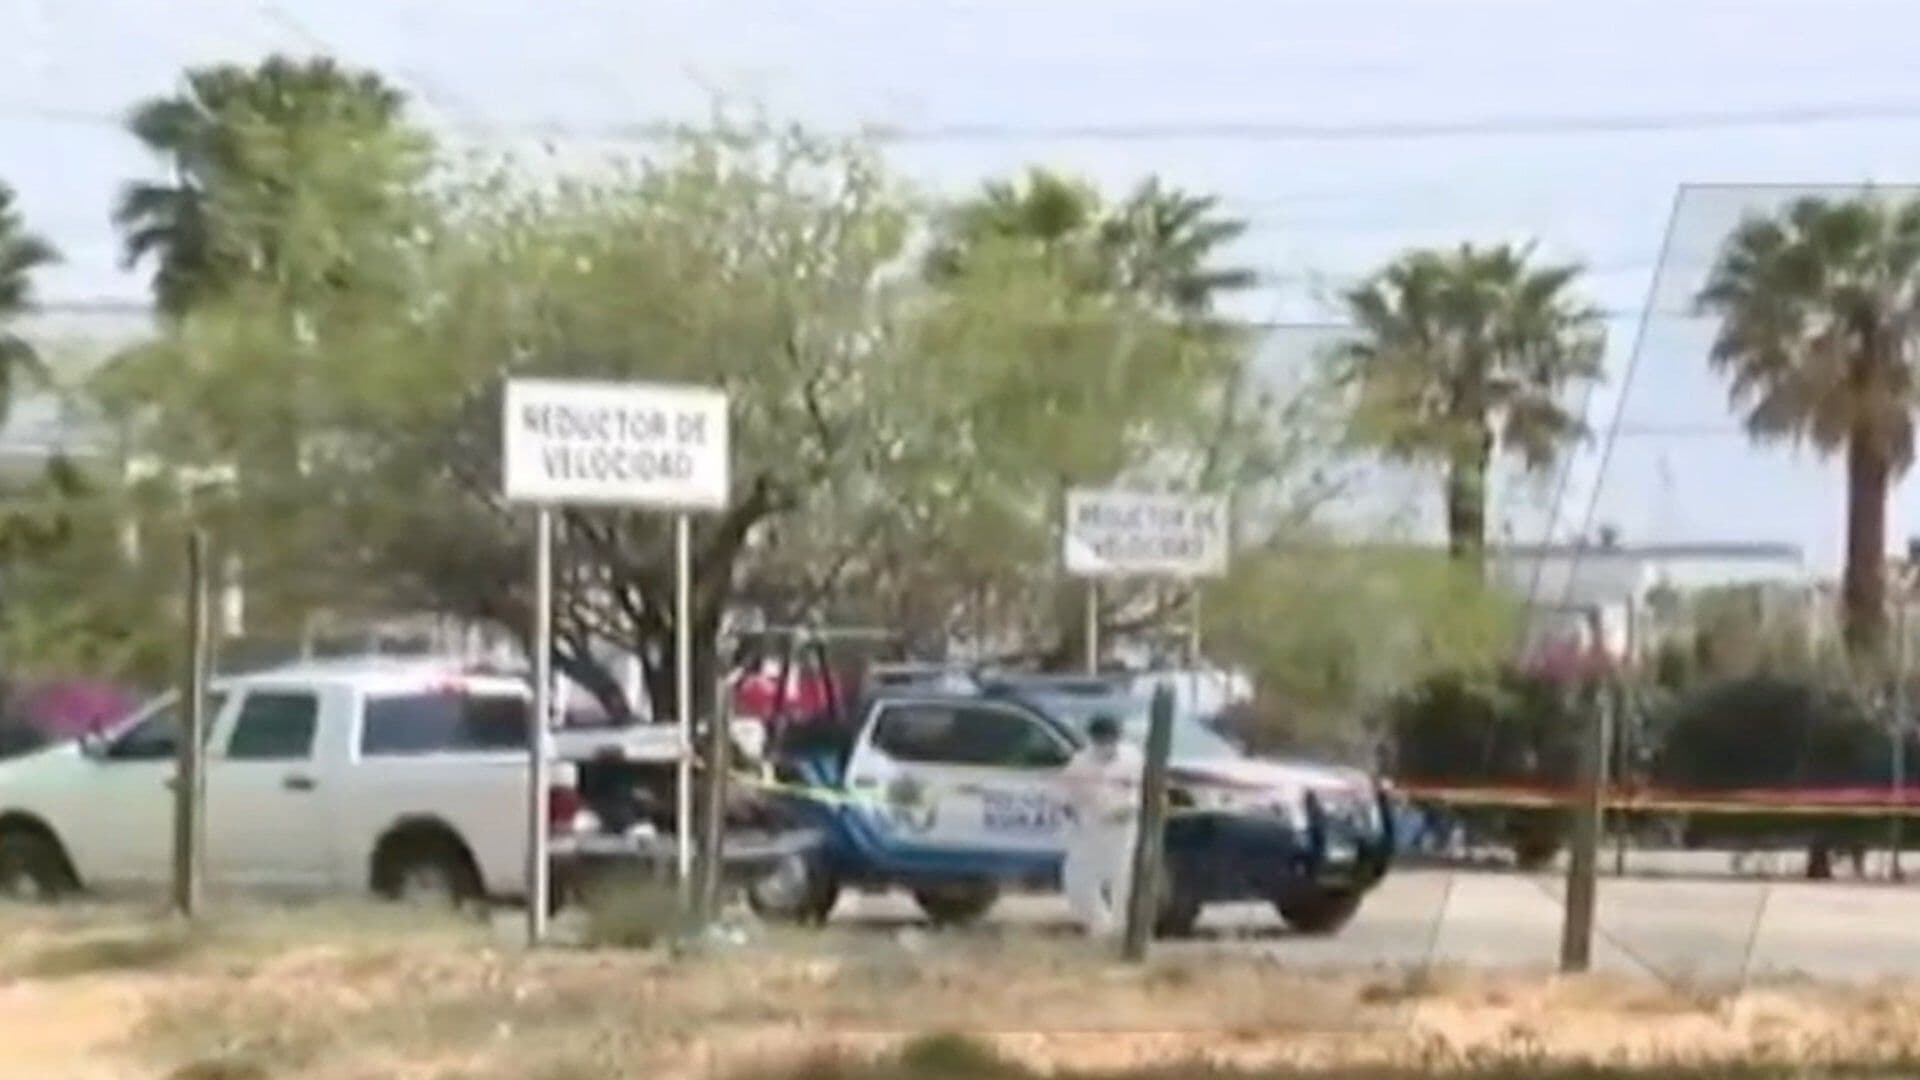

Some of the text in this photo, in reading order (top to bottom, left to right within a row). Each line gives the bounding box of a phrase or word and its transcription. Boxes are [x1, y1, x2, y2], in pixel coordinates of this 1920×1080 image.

[522, 404, 707, 445] REDUCTOR DE
[542, 447, 694, 482] VELOCIDAD
